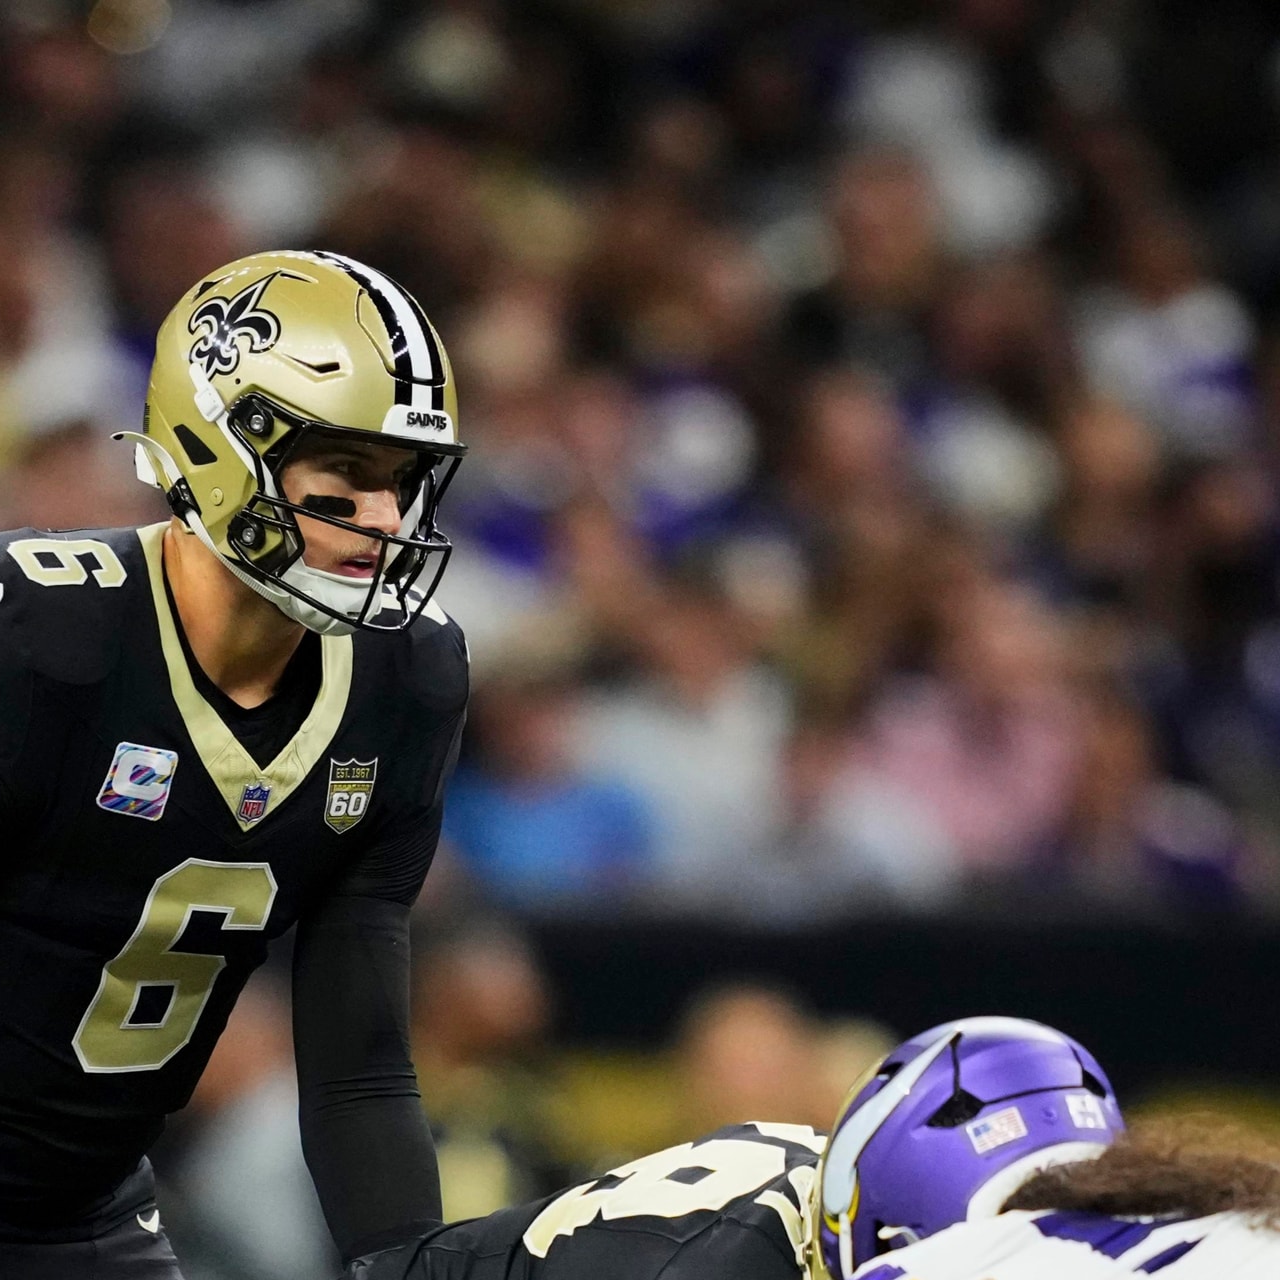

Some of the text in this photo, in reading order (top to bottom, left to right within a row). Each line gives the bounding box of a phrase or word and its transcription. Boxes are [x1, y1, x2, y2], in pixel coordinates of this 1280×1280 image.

[407, 411, 447, 431] SAINTS
[7, 538, 127, 588] 6
[336, 767, 370, 779] EST. 1967
[329, 792, 367, 817] 60
[72, 857, 278, 1073] 6
